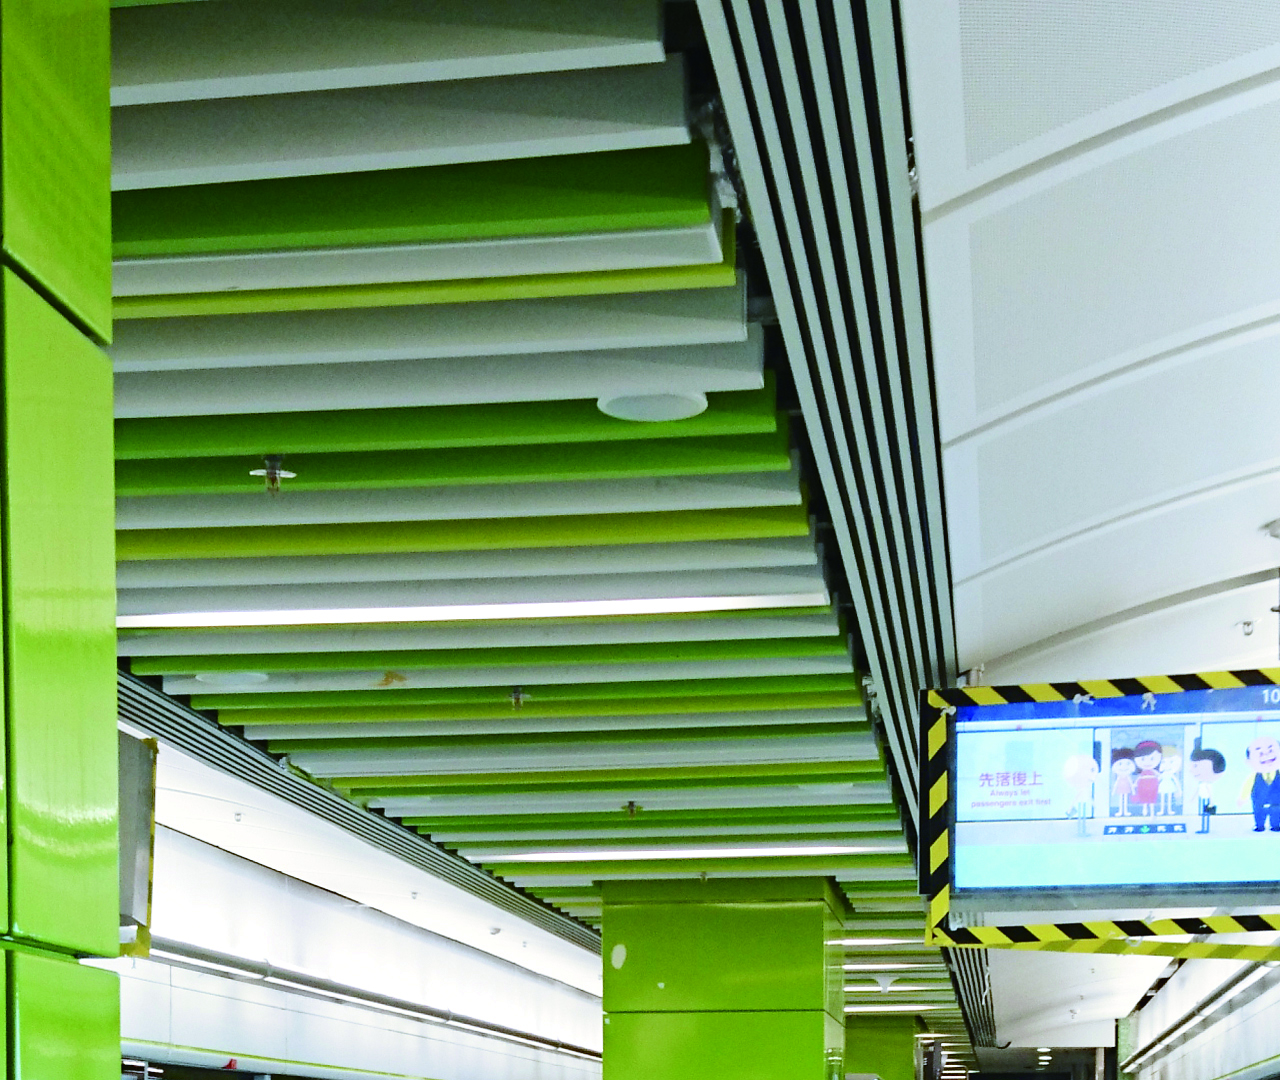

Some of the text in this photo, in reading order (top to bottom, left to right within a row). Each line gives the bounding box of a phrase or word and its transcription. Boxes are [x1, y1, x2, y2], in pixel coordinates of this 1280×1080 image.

[979, 771, 1043, 787] 先落後上
[971, 800, 1017, 808] passengers
